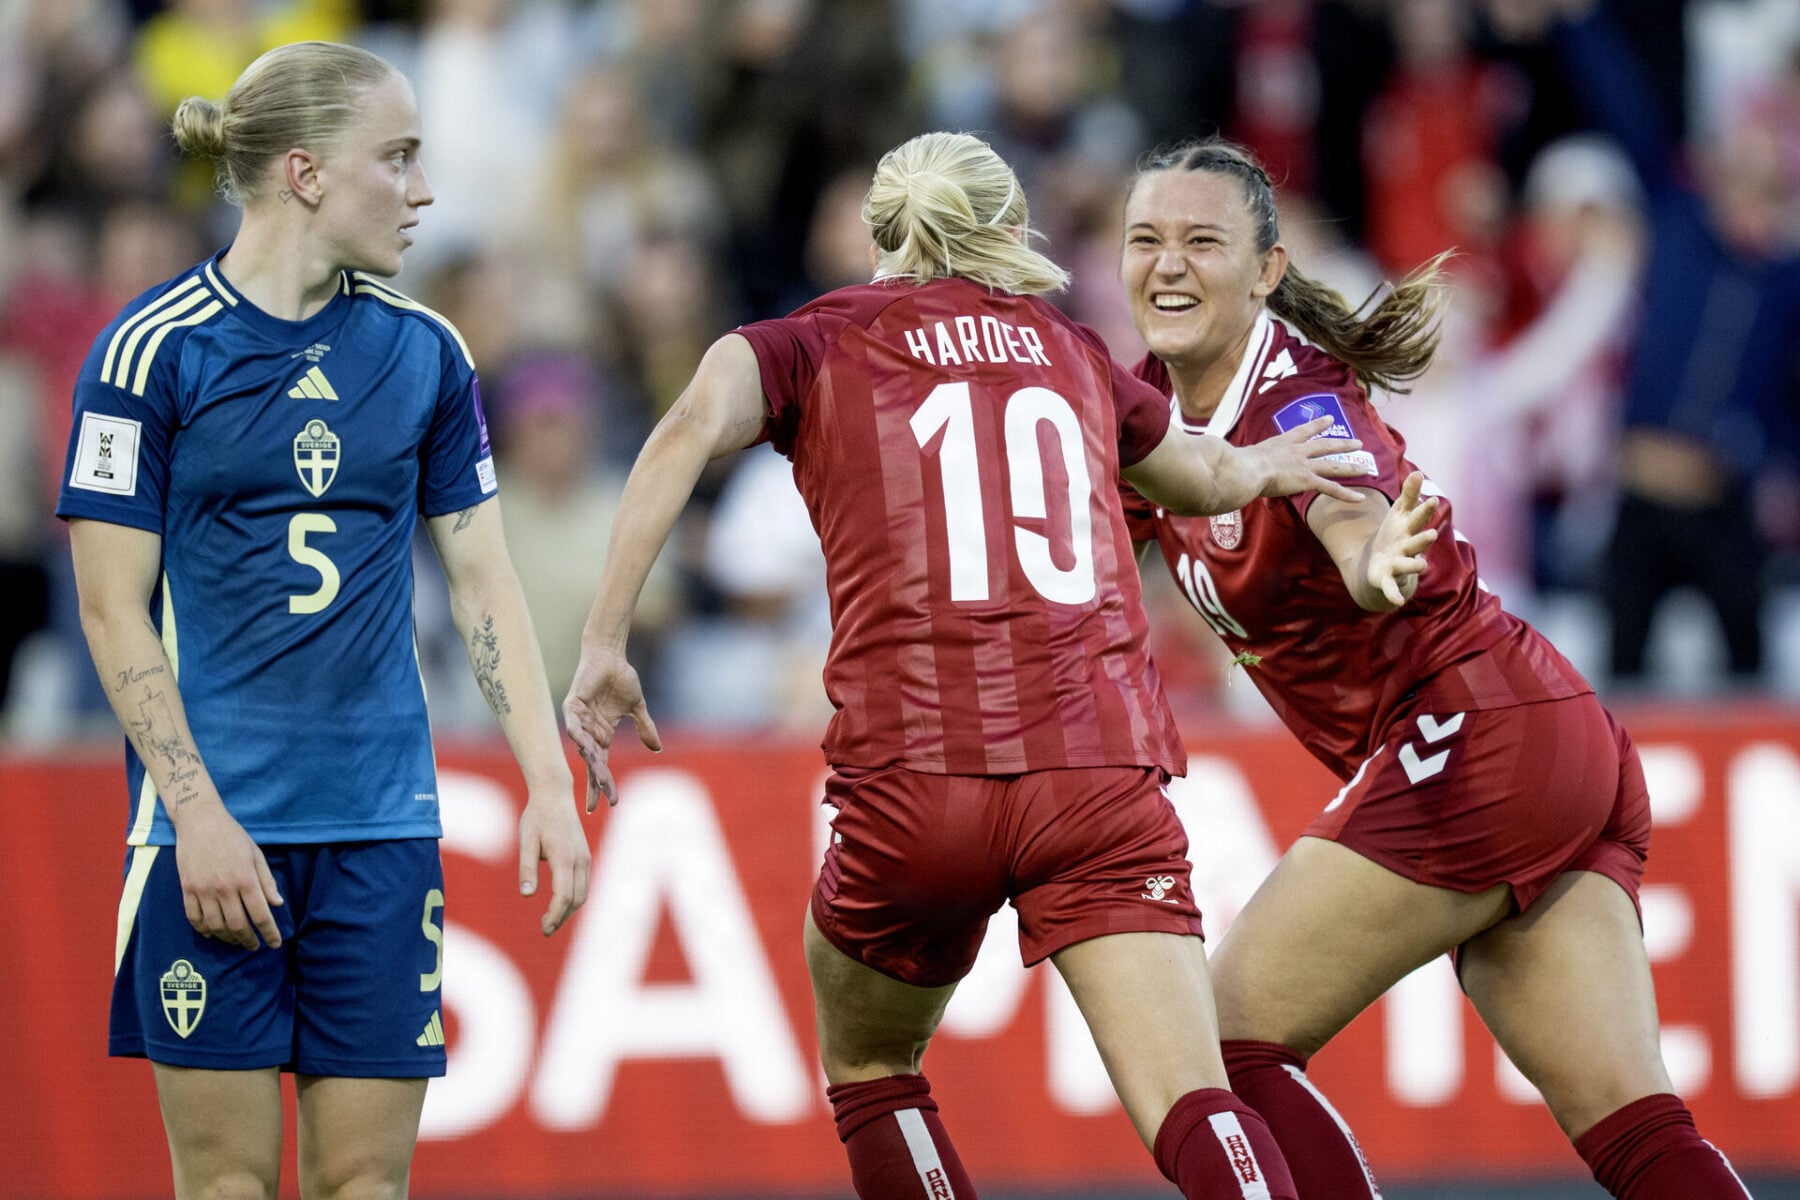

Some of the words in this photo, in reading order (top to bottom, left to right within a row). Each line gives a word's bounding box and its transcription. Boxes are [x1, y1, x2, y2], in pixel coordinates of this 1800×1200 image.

[904, 315, 1052, 367] HARDER
[301, 441, 333, 449] SVERIGE
[287, 513, 341, 614] 5
[115, 664, 164, 692] Mamma
[420, 888, 444, 992] 5
[926, 1168, 951, 1200] DAN
